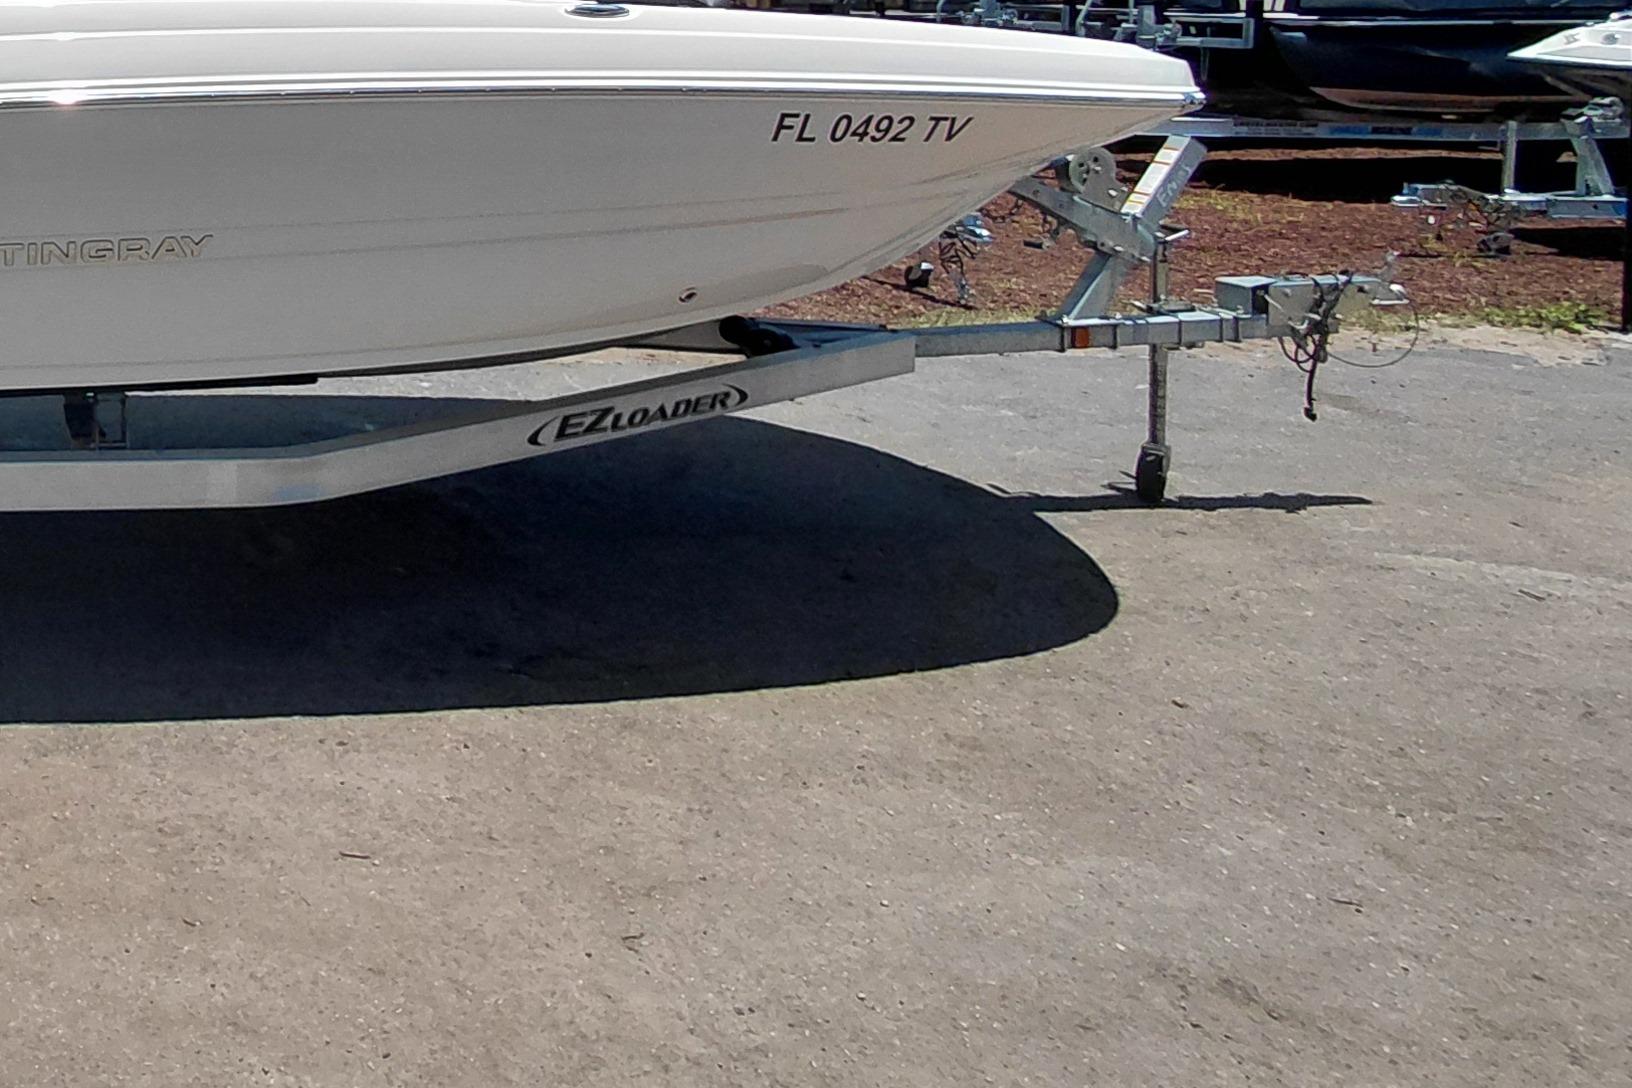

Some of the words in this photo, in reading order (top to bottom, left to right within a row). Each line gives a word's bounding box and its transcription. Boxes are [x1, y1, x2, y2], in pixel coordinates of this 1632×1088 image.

[771, 113, 816, 142] FL
[830, 114, 915, 143] 0492
[923, 117, 974, 143] TV
